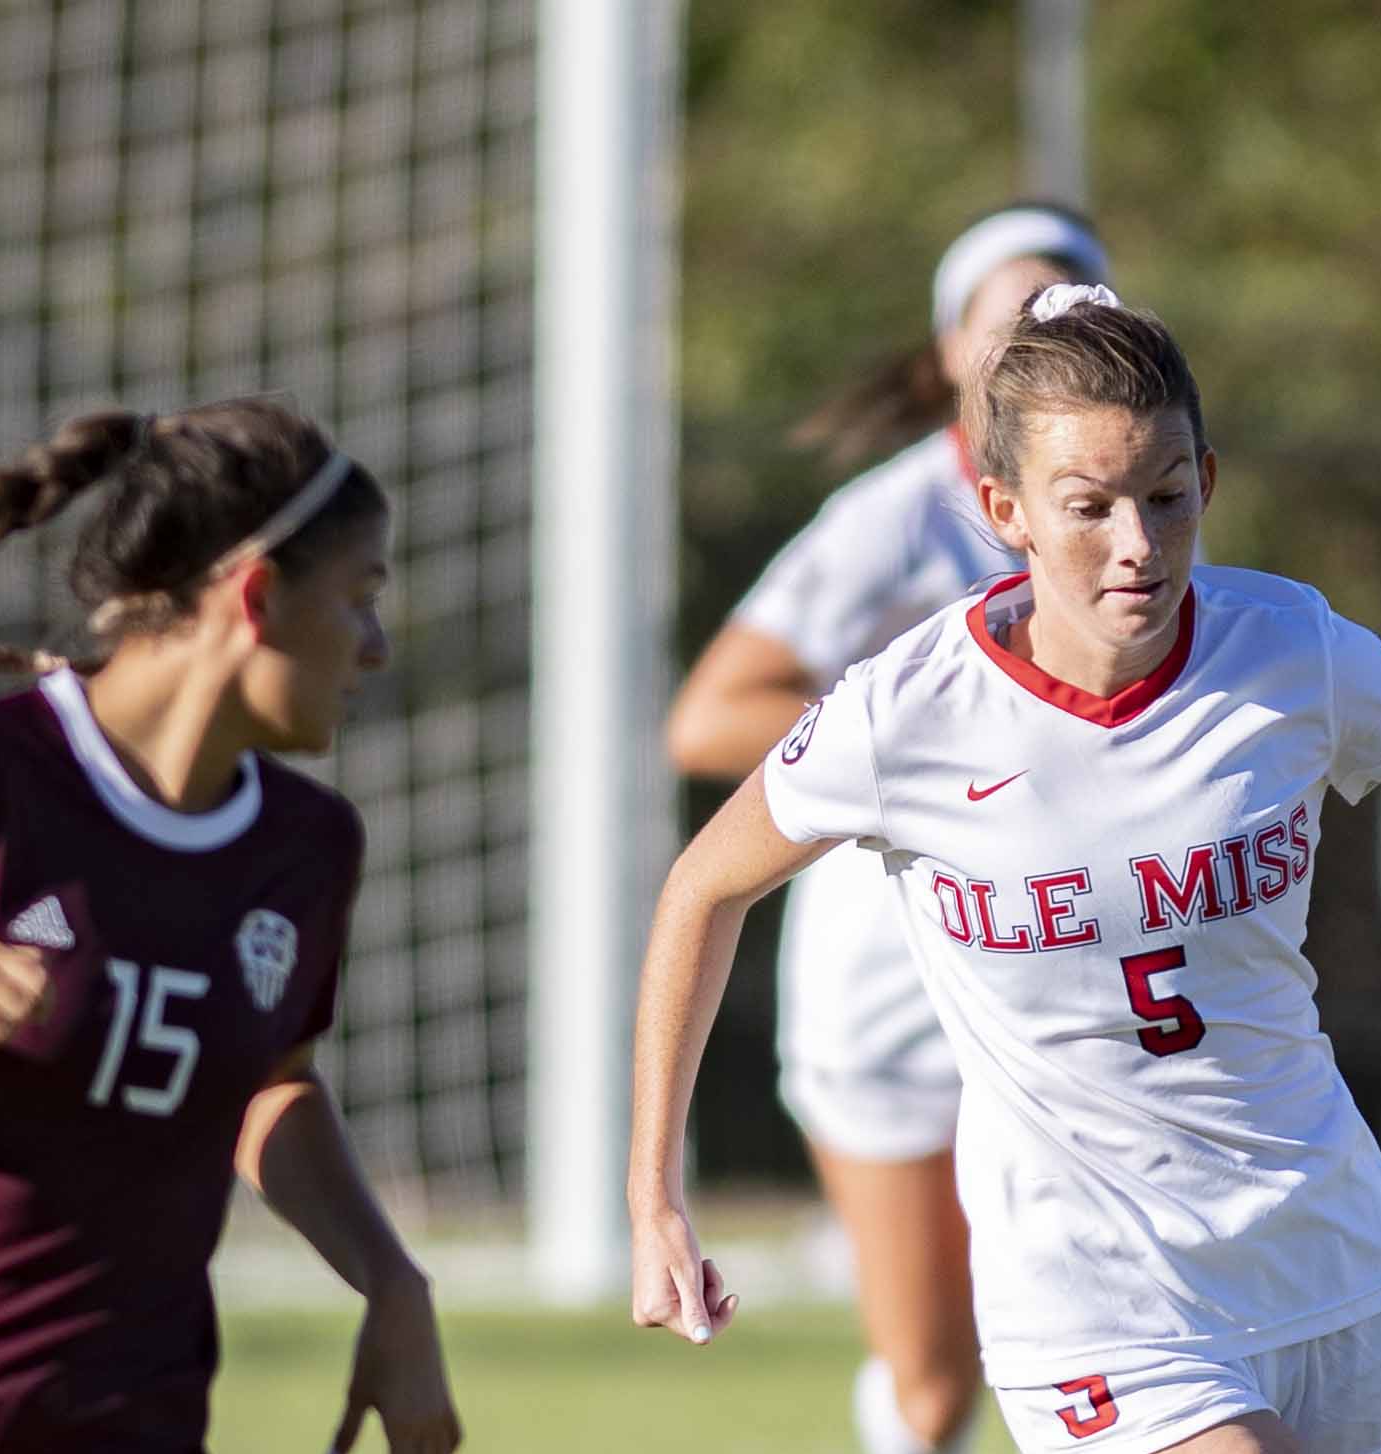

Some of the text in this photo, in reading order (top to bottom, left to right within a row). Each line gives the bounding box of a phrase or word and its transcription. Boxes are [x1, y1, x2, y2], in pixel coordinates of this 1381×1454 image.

[932, 801, 1311, 953] OLE MISS
[87, 956, 212, 1117] 15
[1120, 945, 1206, 1057] 5
